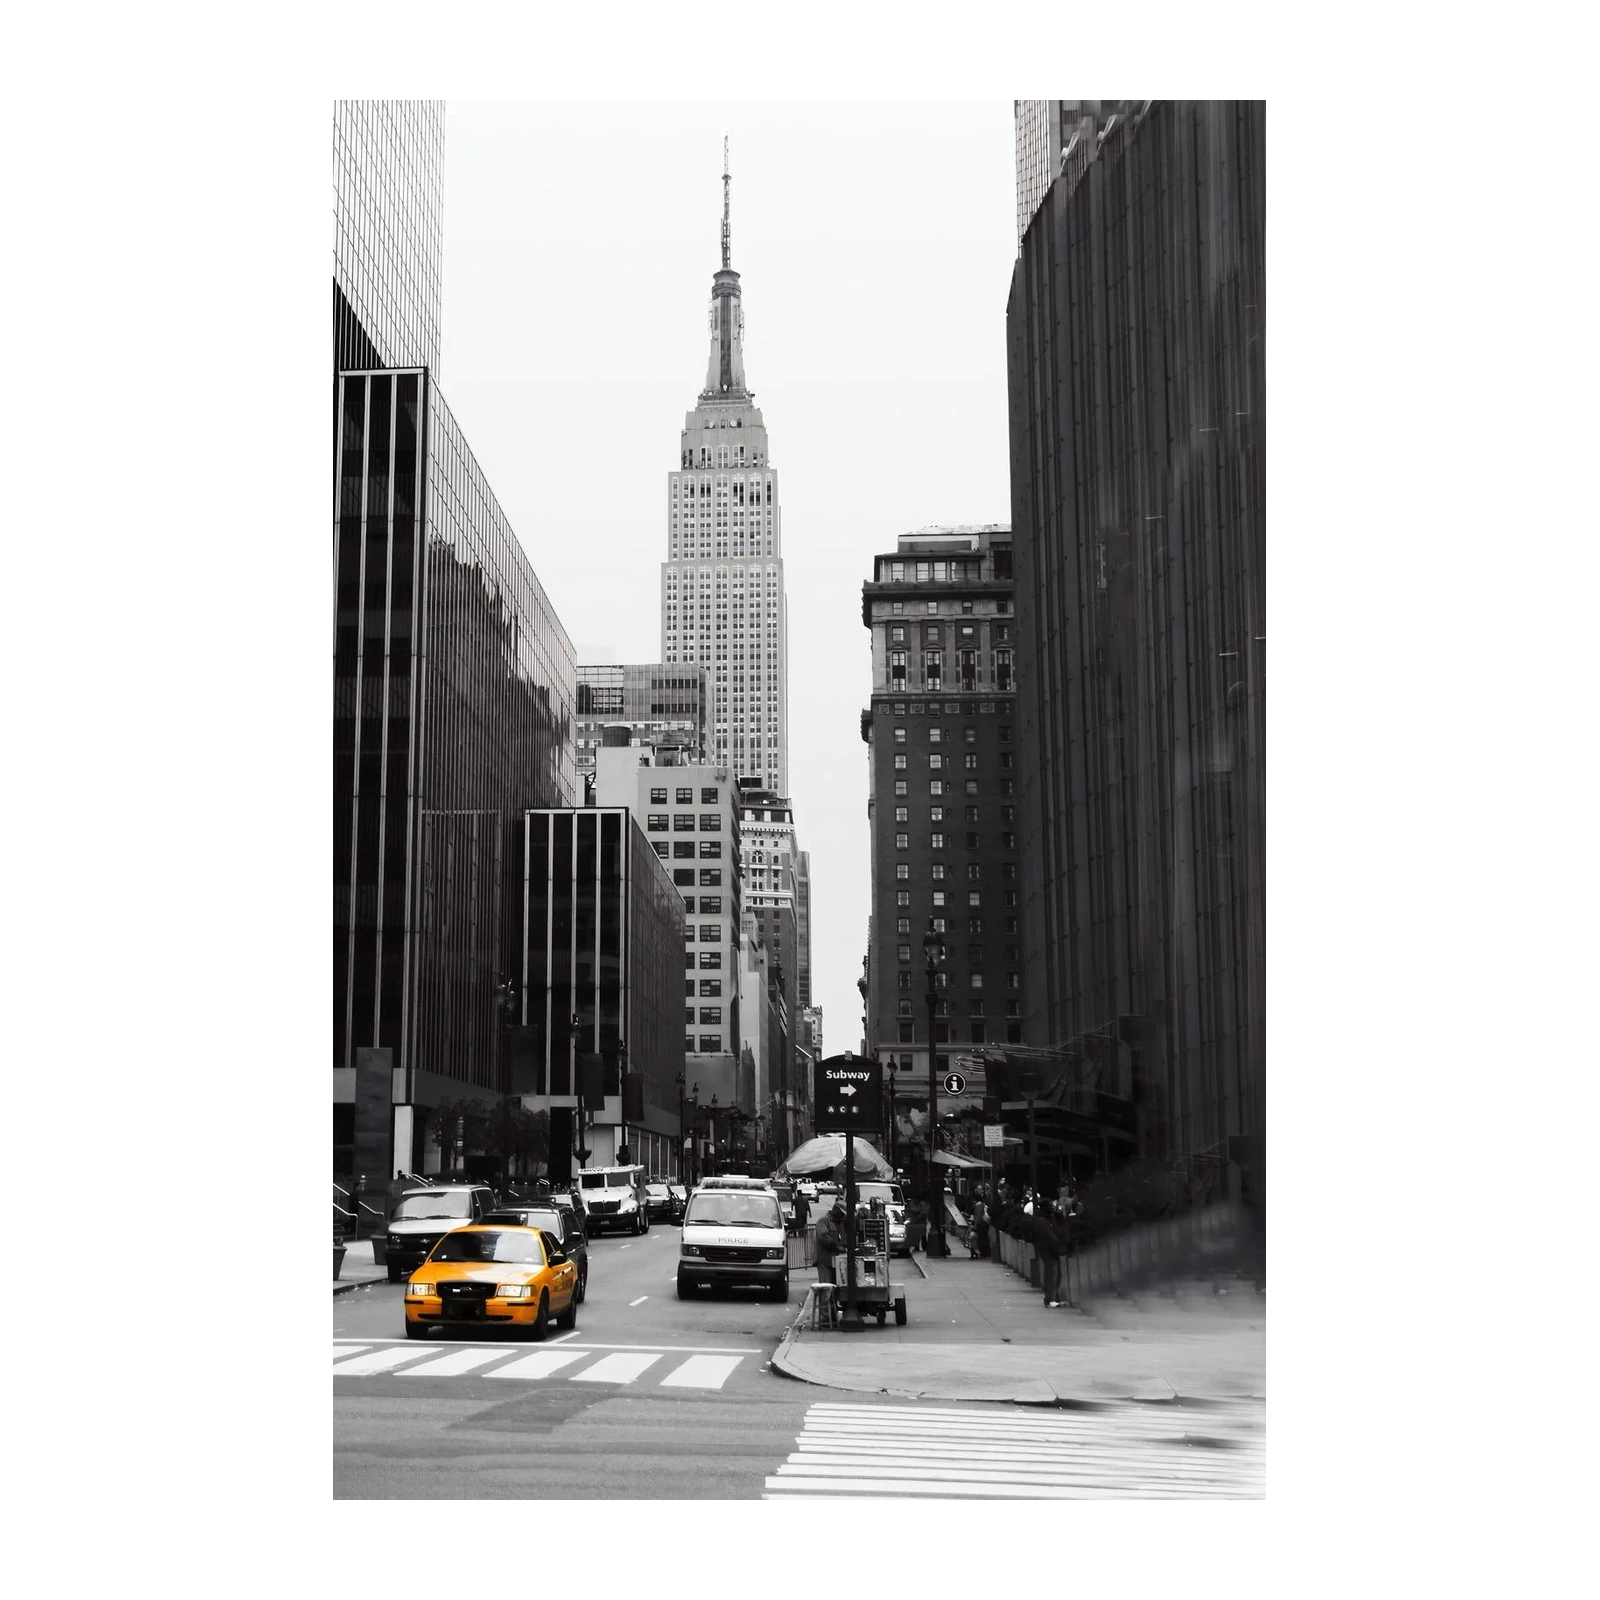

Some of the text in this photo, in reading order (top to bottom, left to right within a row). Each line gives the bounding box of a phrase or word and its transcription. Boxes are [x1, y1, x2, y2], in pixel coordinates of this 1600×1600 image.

[826, 1069, 870, 1082] Subway
[828, 1105, 835, 1113] A
[839, 1105, 846, 1113] C
[718, 1236, 749, 1244] POLICE
